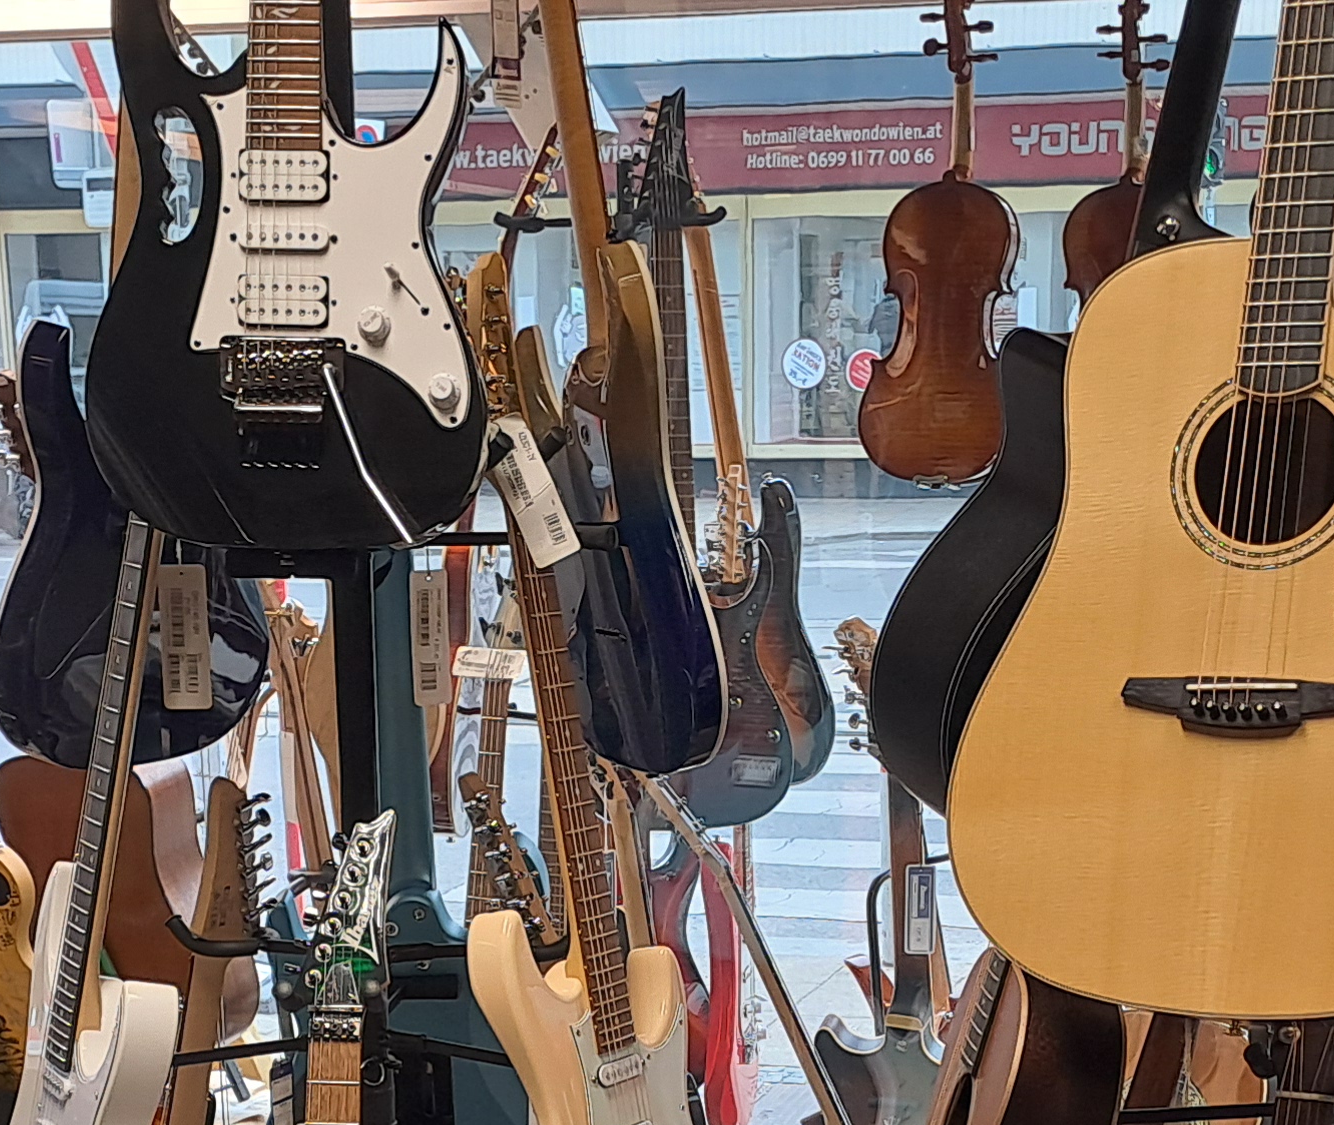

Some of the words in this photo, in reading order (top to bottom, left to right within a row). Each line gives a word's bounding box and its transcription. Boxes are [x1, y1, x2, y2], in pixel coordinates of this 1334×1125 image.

[742, 122, 943, 146] hotmail@taekwondowien.at
[747, 153, 805, 169] Hotline:
[807, 151, 847, 169] 0699
[851, 150, 863, 167] 11
[868, 149, 885, 166] 77
[889, 148, 910, 165] 00
[914, 147, 935, 165] 66
